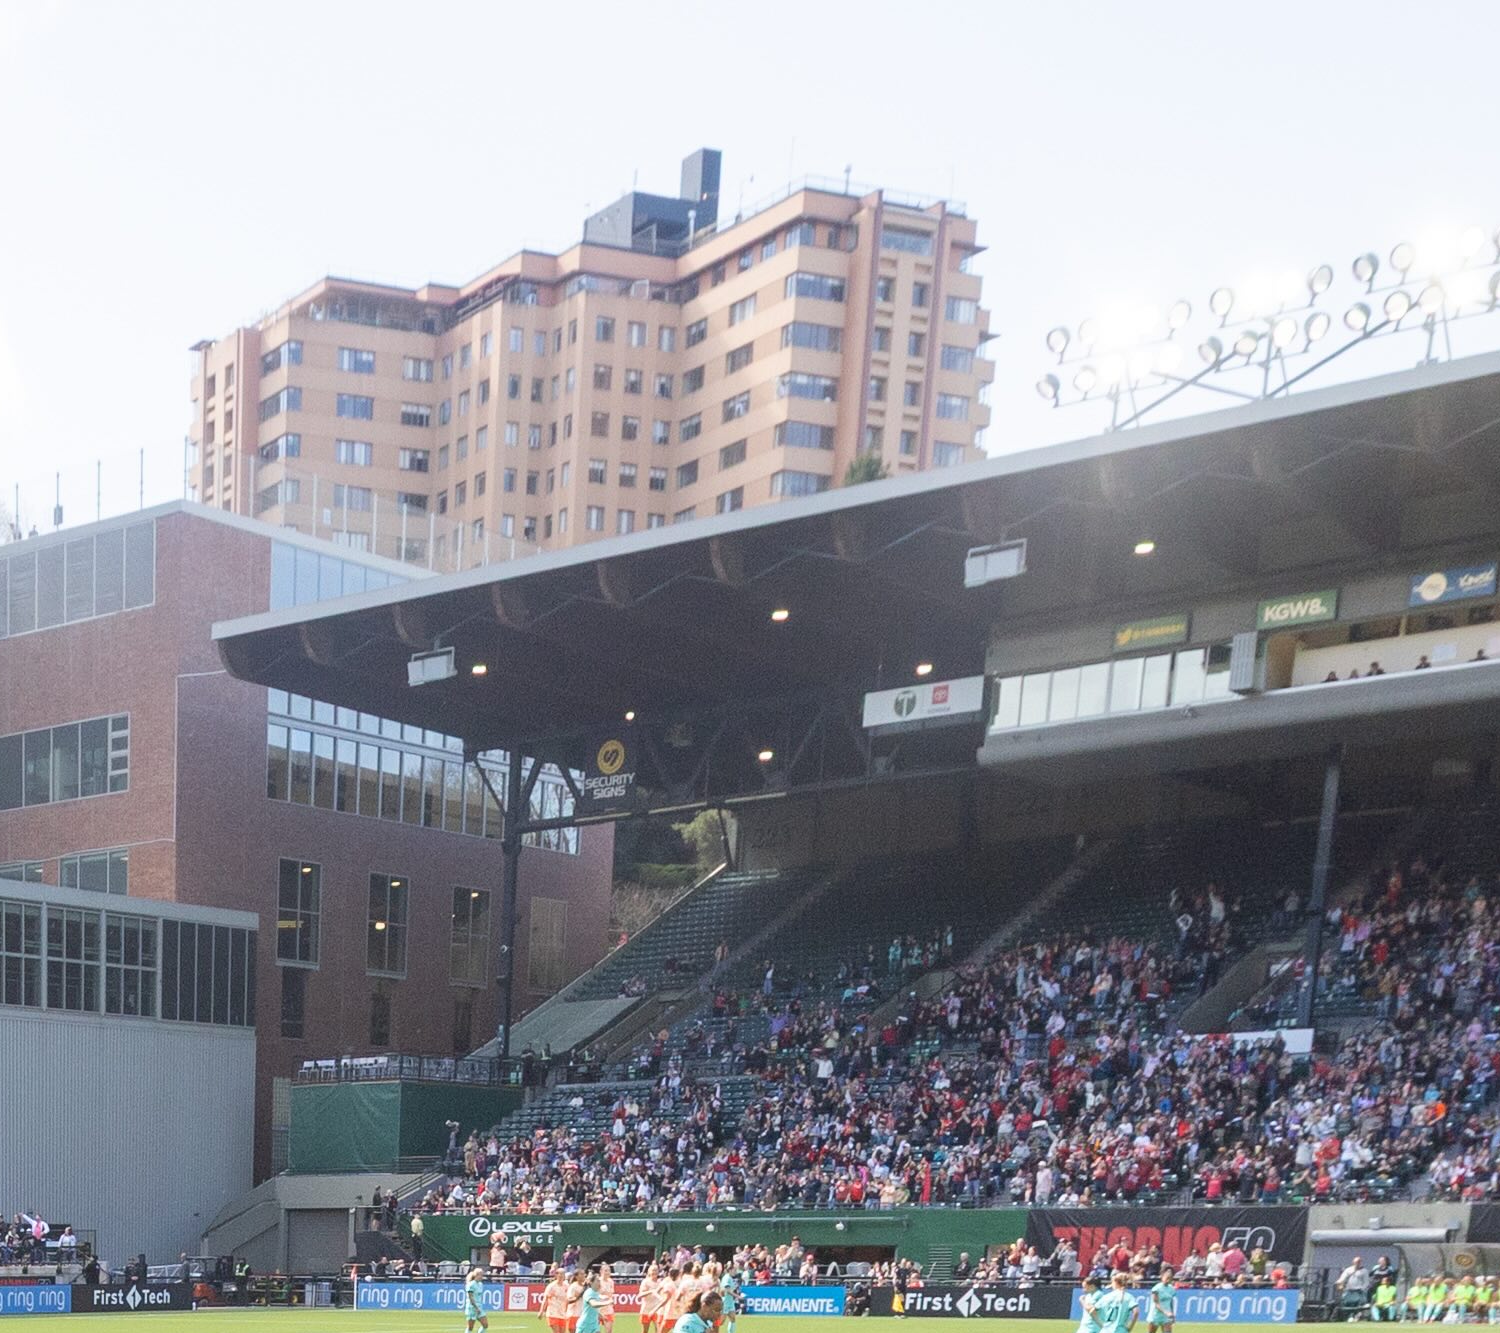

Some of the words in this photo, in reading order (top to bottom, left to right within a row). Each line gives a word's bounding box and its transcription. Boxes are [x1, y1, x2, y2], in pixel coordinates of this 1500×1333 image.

[586, 772, 636, 790] SECURITY
[593, 785, 627, 799] SIGNS
[492, 1221, 555, 1232] LEXUS
[8, 1287, 35, 1312] ring
[39, 1286, 65, 1310] ring
[94, 1287, 125, 1305] First
[141, 1288, 171, 1305] Tech
[361, 1283, 389, 1308] ring
[395, 1284, 424, 1309] ring
[747, 1297, 837, 1313] PERMANENTE
[906, 1292, 953, 1311] First
[984, 1293, 1031, 1312] Tech
[1186, 1292, 1232, 1320] ring
[1240, 1292, 1287, 1320] ring
